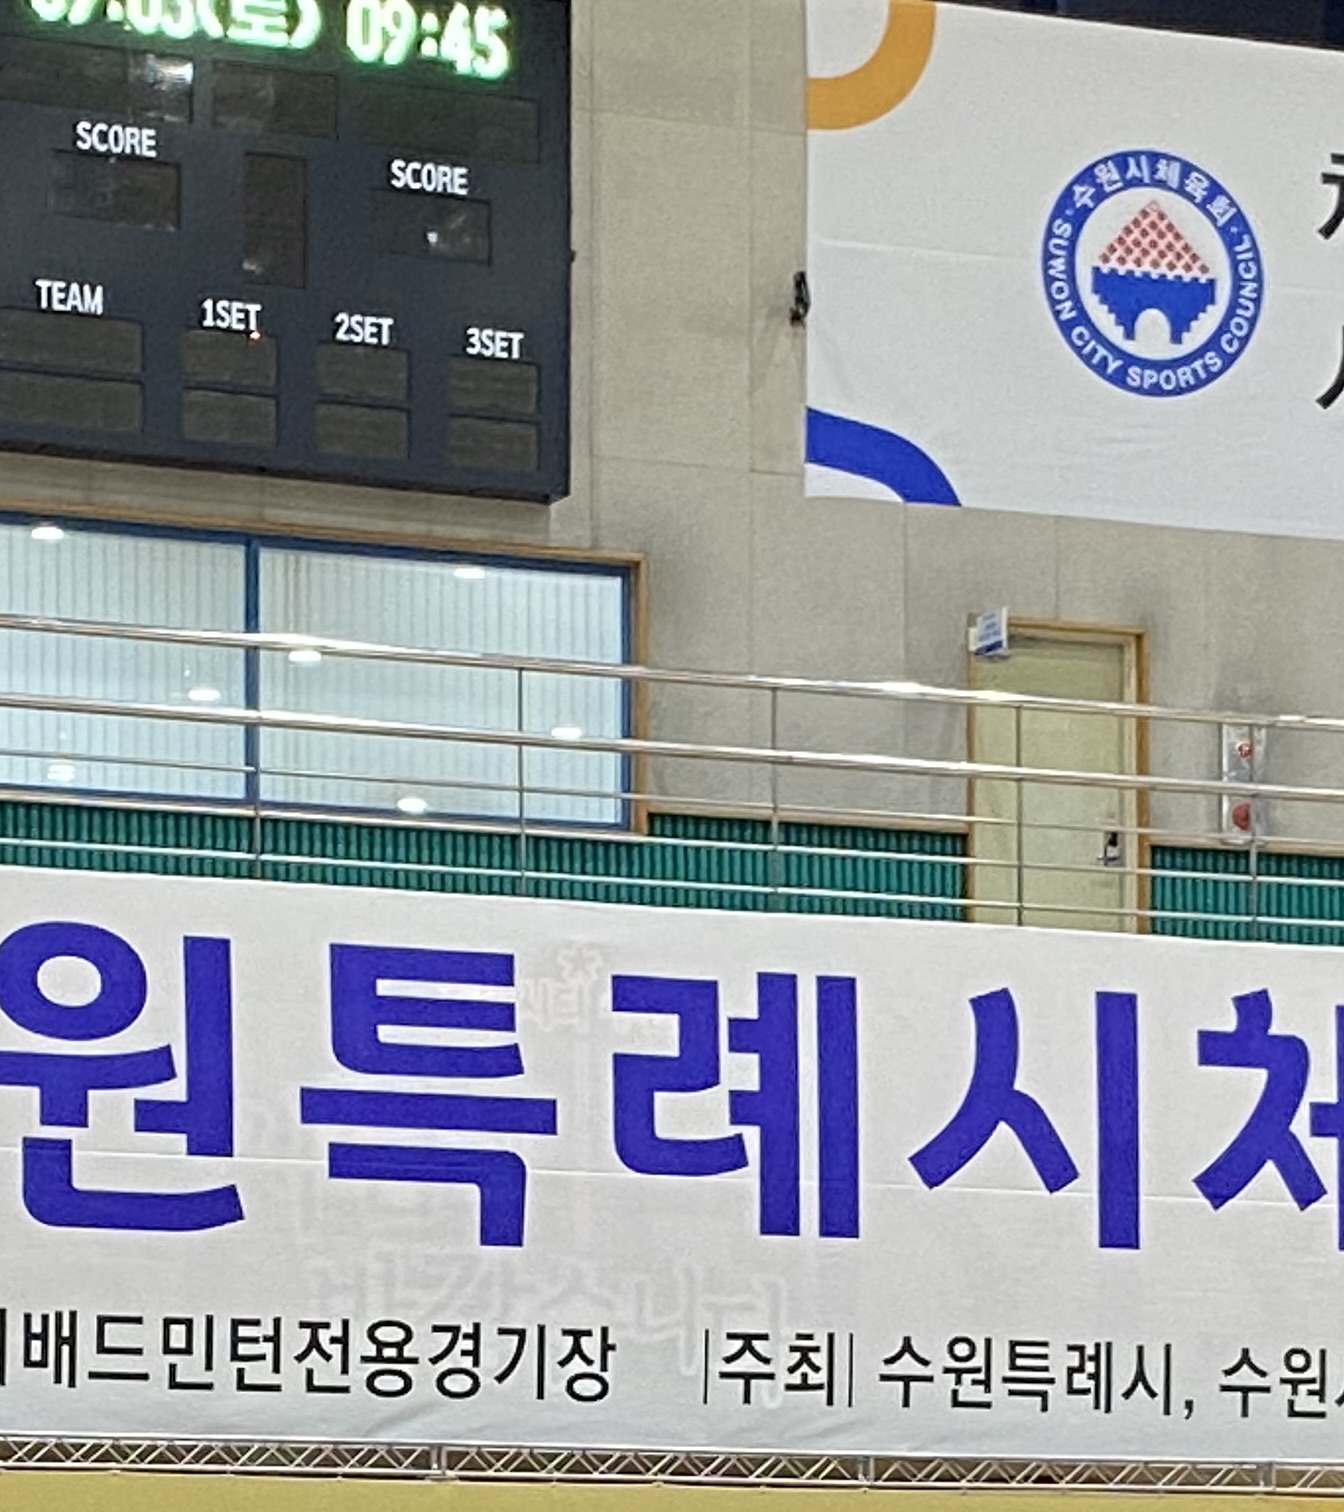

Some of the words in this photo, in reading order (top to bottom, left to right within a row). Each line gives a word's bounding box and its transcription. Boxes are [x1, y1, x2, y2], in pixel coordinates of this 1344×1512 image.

[347, 0, 511, 79] 09:45
[76, 121, 157, 158] SCORE
[390, 160, 468, 195] SCORE
[1072, 155, 1237, 228] 수원시체육회
[35, 279, 104, 315] TEAM
[202, 299, 262, 332] 1SET
[334, 313, 395, 346] 2SET
[466, 328, 525, 360] 3SET
[1048, 218, 1077, 322] SUWON
[1071, 326, 1123, 375] CITY
[1126, 351, 1222, 390] SPORTS
[1219, 234, 1258, 353] COUNCIL
[879, 1335, 1194, 1420] 수원특례시,
